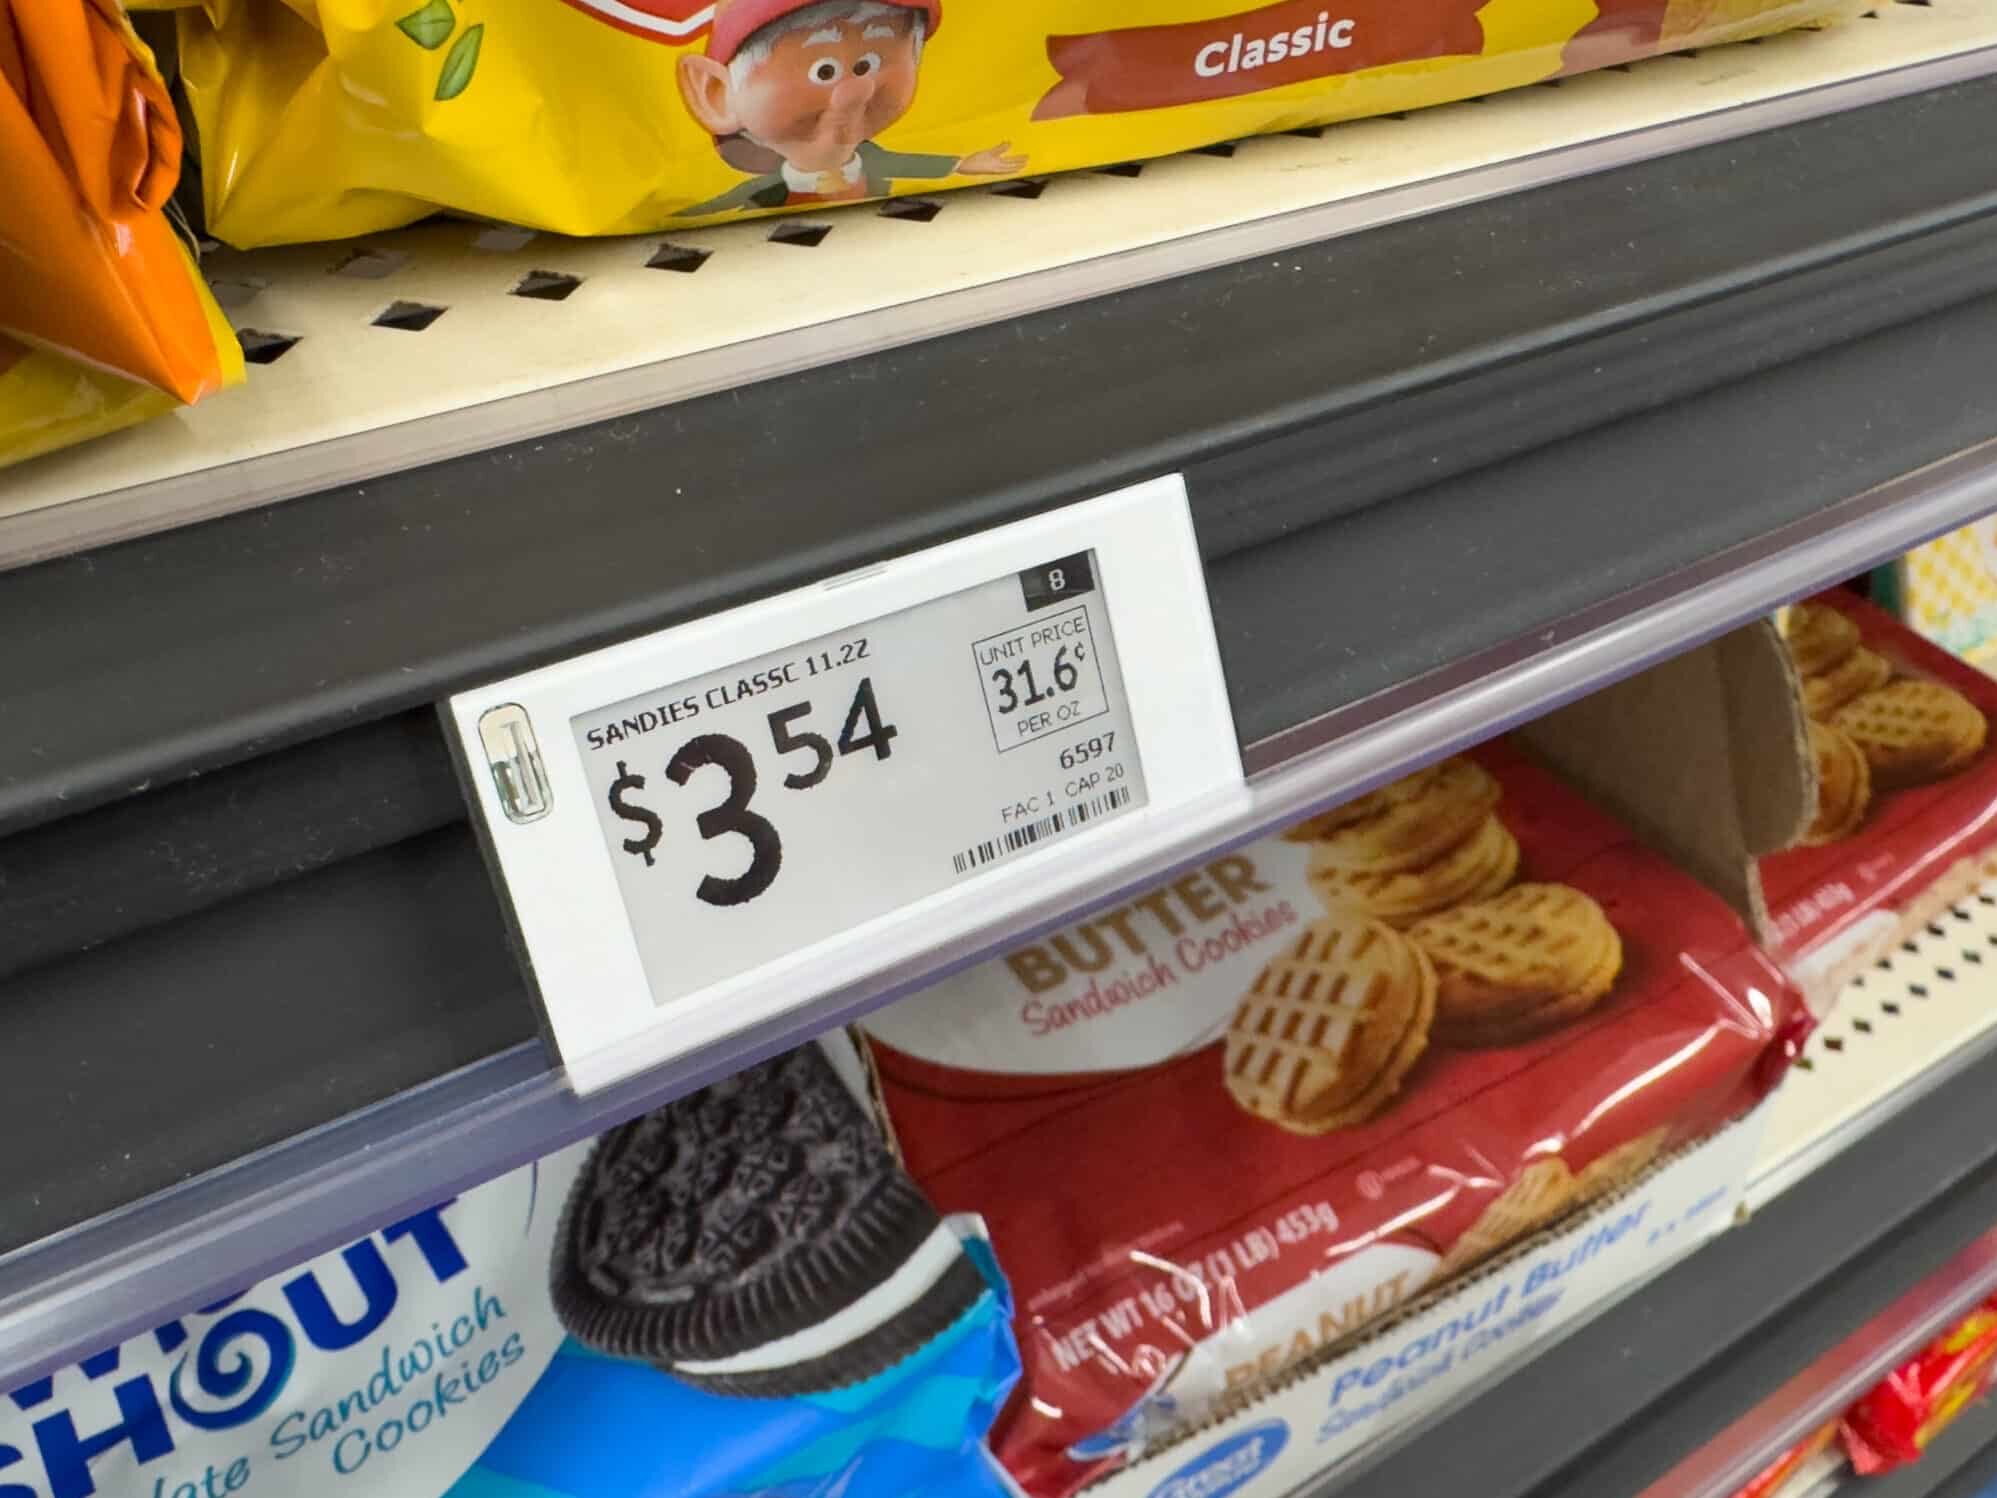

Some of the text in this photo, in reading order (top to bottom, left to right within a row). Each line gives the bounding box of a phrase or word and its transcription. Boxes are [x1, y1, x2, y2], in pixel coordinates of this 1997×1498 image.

[1194, 11, 1356, 77] Classic
[1048, 568, 1066, 591] 8
[980, 615, 1086, 666] UNIT PRICE
[586, 696, 700, 751] SANDIES
[705, 662, 800, 710] CLASSC
[1017, 701, 1081, 737] PER OZ
[1059, 732, 1116, 770] 6597
[1001, 763, 1125, 824] FAC 1 CAP 20
[1006, 852, 1272, 993] BUTTER
[1020, 901, 1299, 1037] Sandwich Cookies
[1053, 1317, 1098, 1373] NET
[1098, 1297, 1144, 1340] WT
[1139, 1281, 1176, 1319] 16
[1276, 1200, 1340, 1244] 453g
[0, 1198, 469, 1498] HOUT
[269, 1285, 508, 1461] Sandwich
[1328, 1284, 1512, 1407] Peanut
[332, 1332, 525, 1476] Cookies
